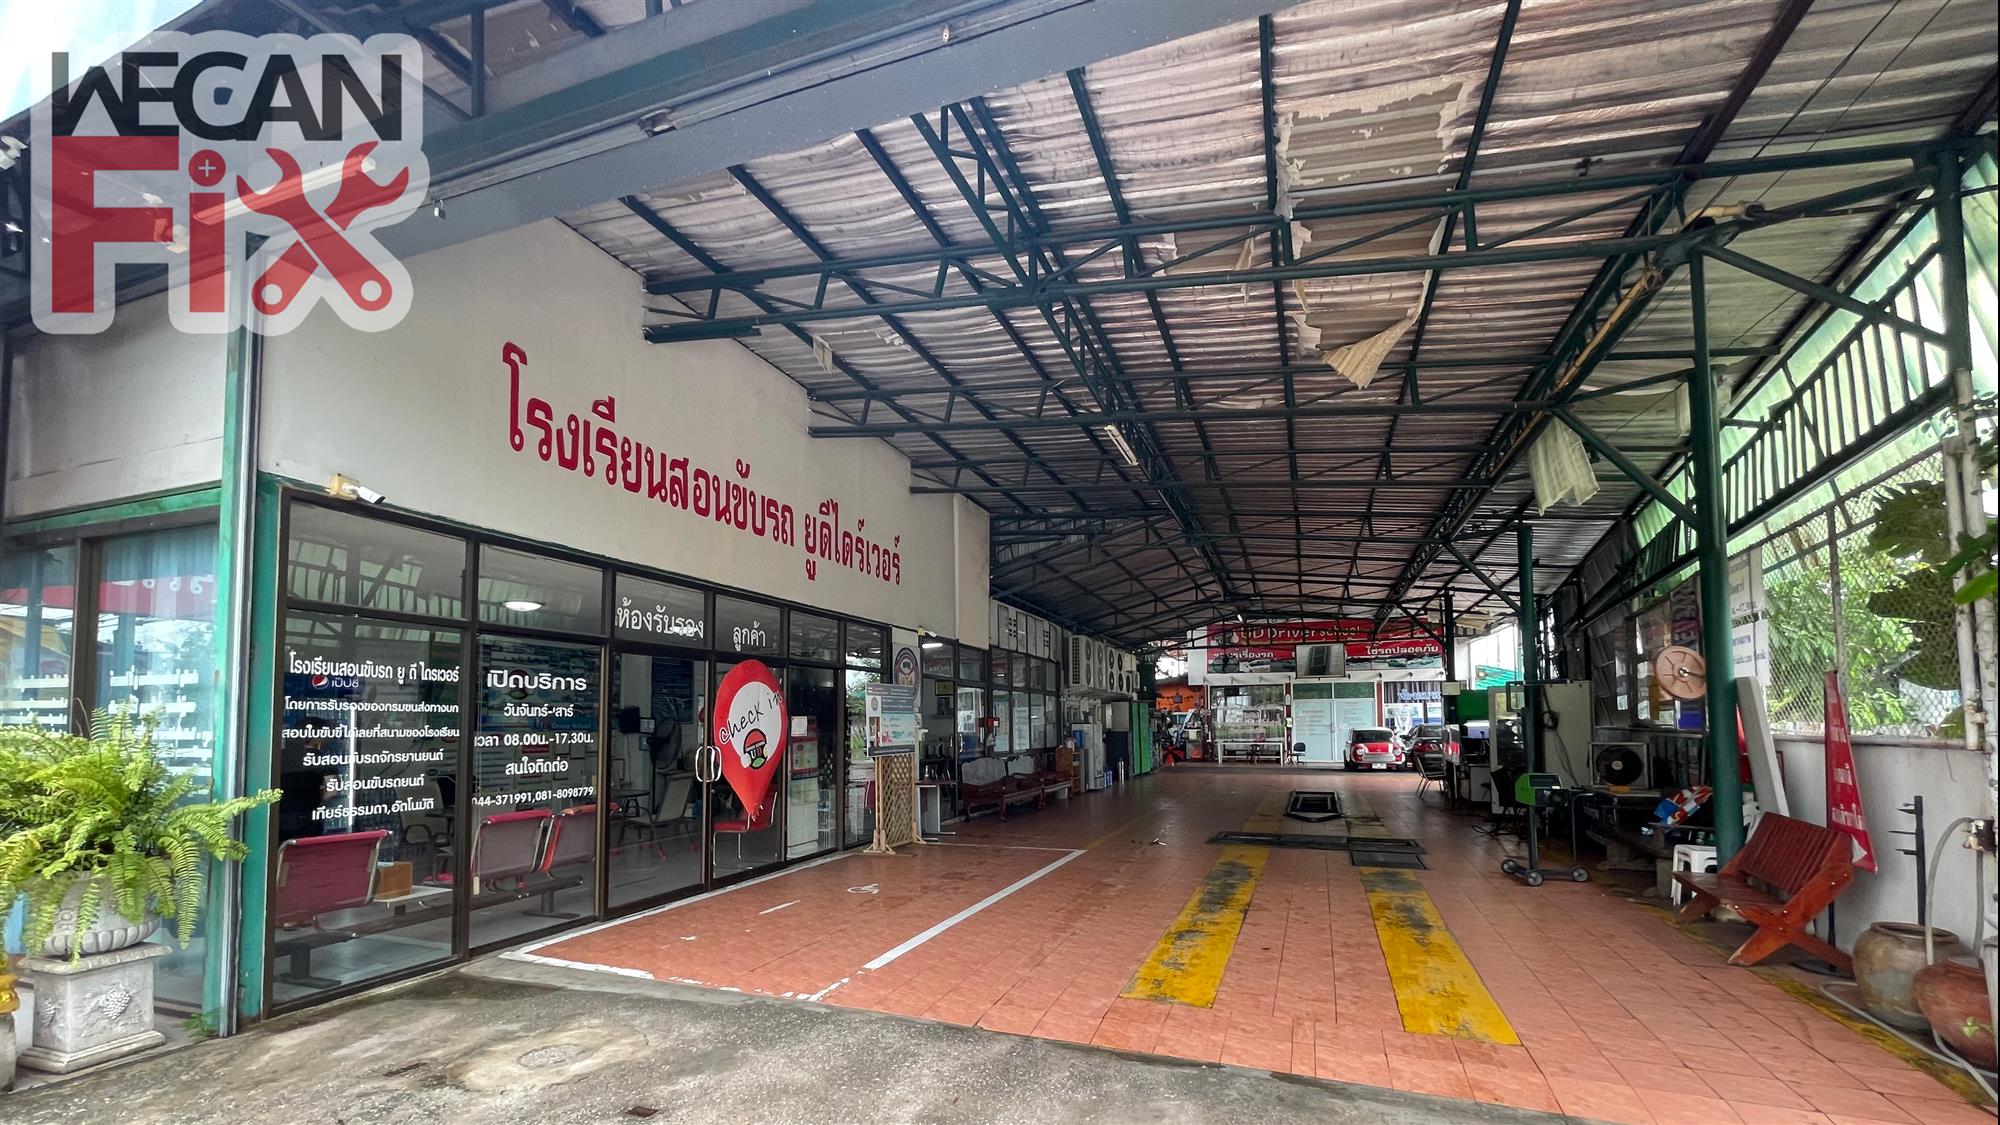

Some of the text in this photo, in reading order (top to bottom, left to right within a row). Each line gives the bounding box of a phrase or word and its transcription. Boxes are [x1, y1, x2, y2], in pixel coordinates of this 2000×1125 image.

[502, 341, 901, 586] โรงเรียนสอนขับรถ ยูดีไดร์เวอร์
[616, 596, 704, 640] ห้องรับรอง
[732, 620, 766, 651] ลูกค้า
[1267, 627, 1316, 640] Driver
[289, 651, 460, 684] โรงเรียนสอนขับรถ ยู ดี ไดรเวอร์
[487, 669, 588, 691] เปิดบริการ
[284, 696, 459, 713] โดยการรับรองของกรมขนส่งทางบก
[473, 732, 594, 747] เวลา 08.00น.-17.30น.
[505, 756, 569, 776] สนใจติดต่อ
